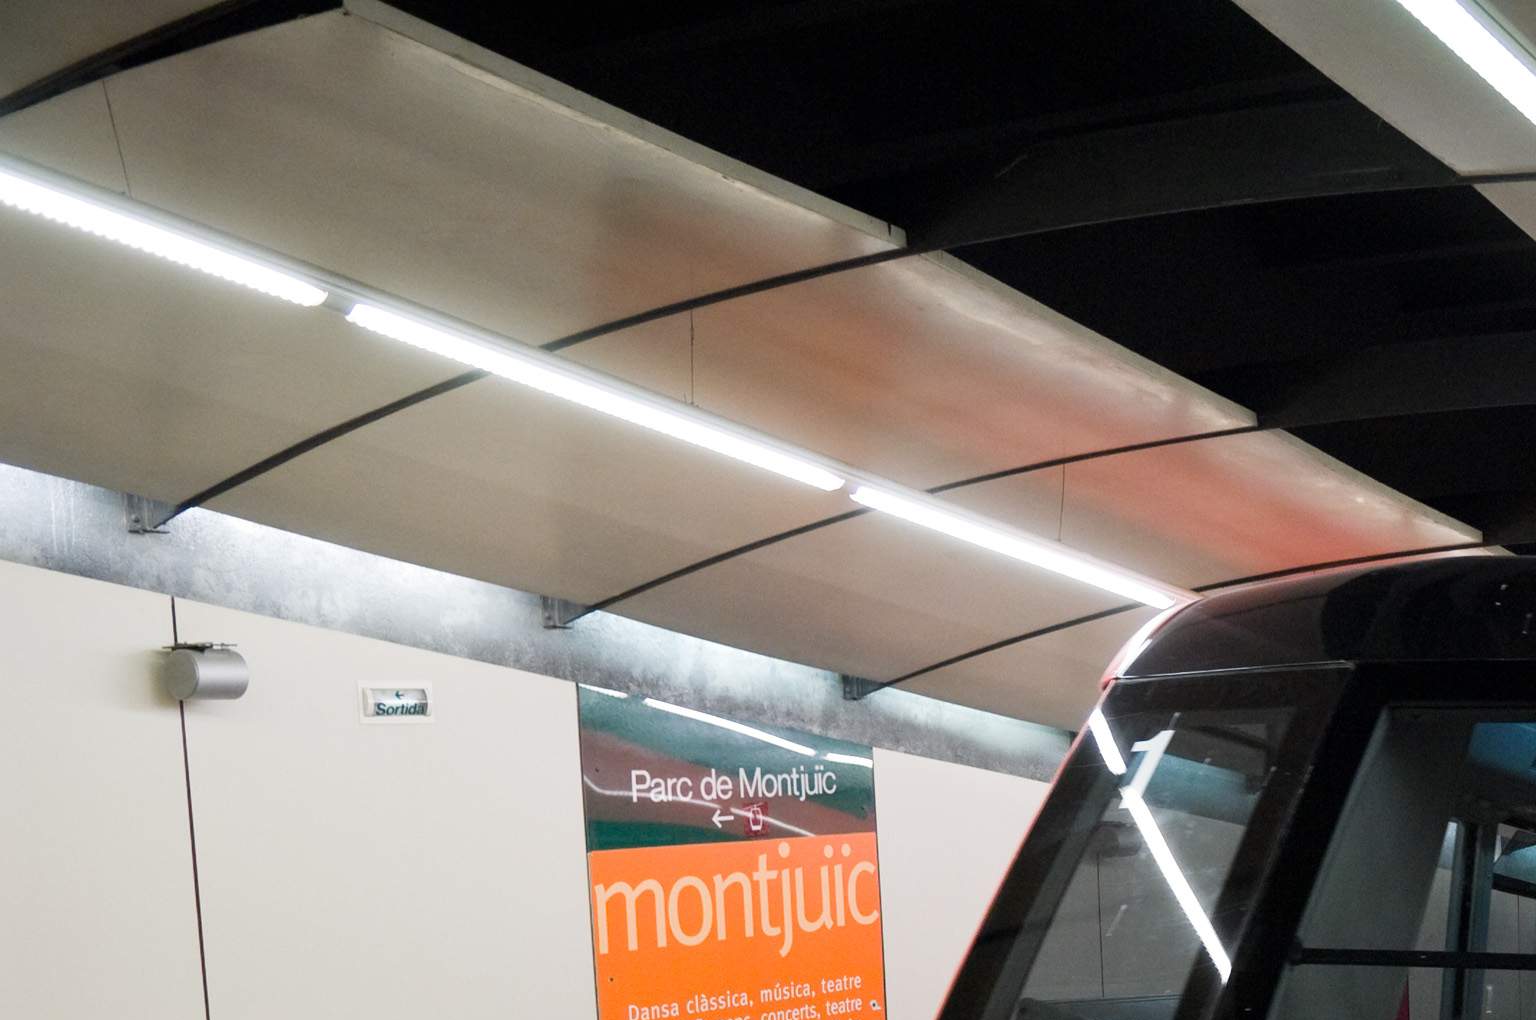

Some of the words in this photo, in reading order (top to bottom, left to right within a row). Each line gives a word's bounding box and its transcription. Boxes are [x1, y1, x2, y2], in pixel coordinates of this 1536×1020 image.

[375, 702, 425, 716] Sortida
[631, 769, 692, 803] Parc
[700, 768, 732, 800] de
[739, 765, 837, 801] Montjuïc
[594, 841, 879, 958] montjuïc
[686, 990, 753, 1014] clàssica,
[760, 982, 816, 1004] música,
[821, 975, 862, 994] teatre
[826, 997, 863, 1016] teatre
